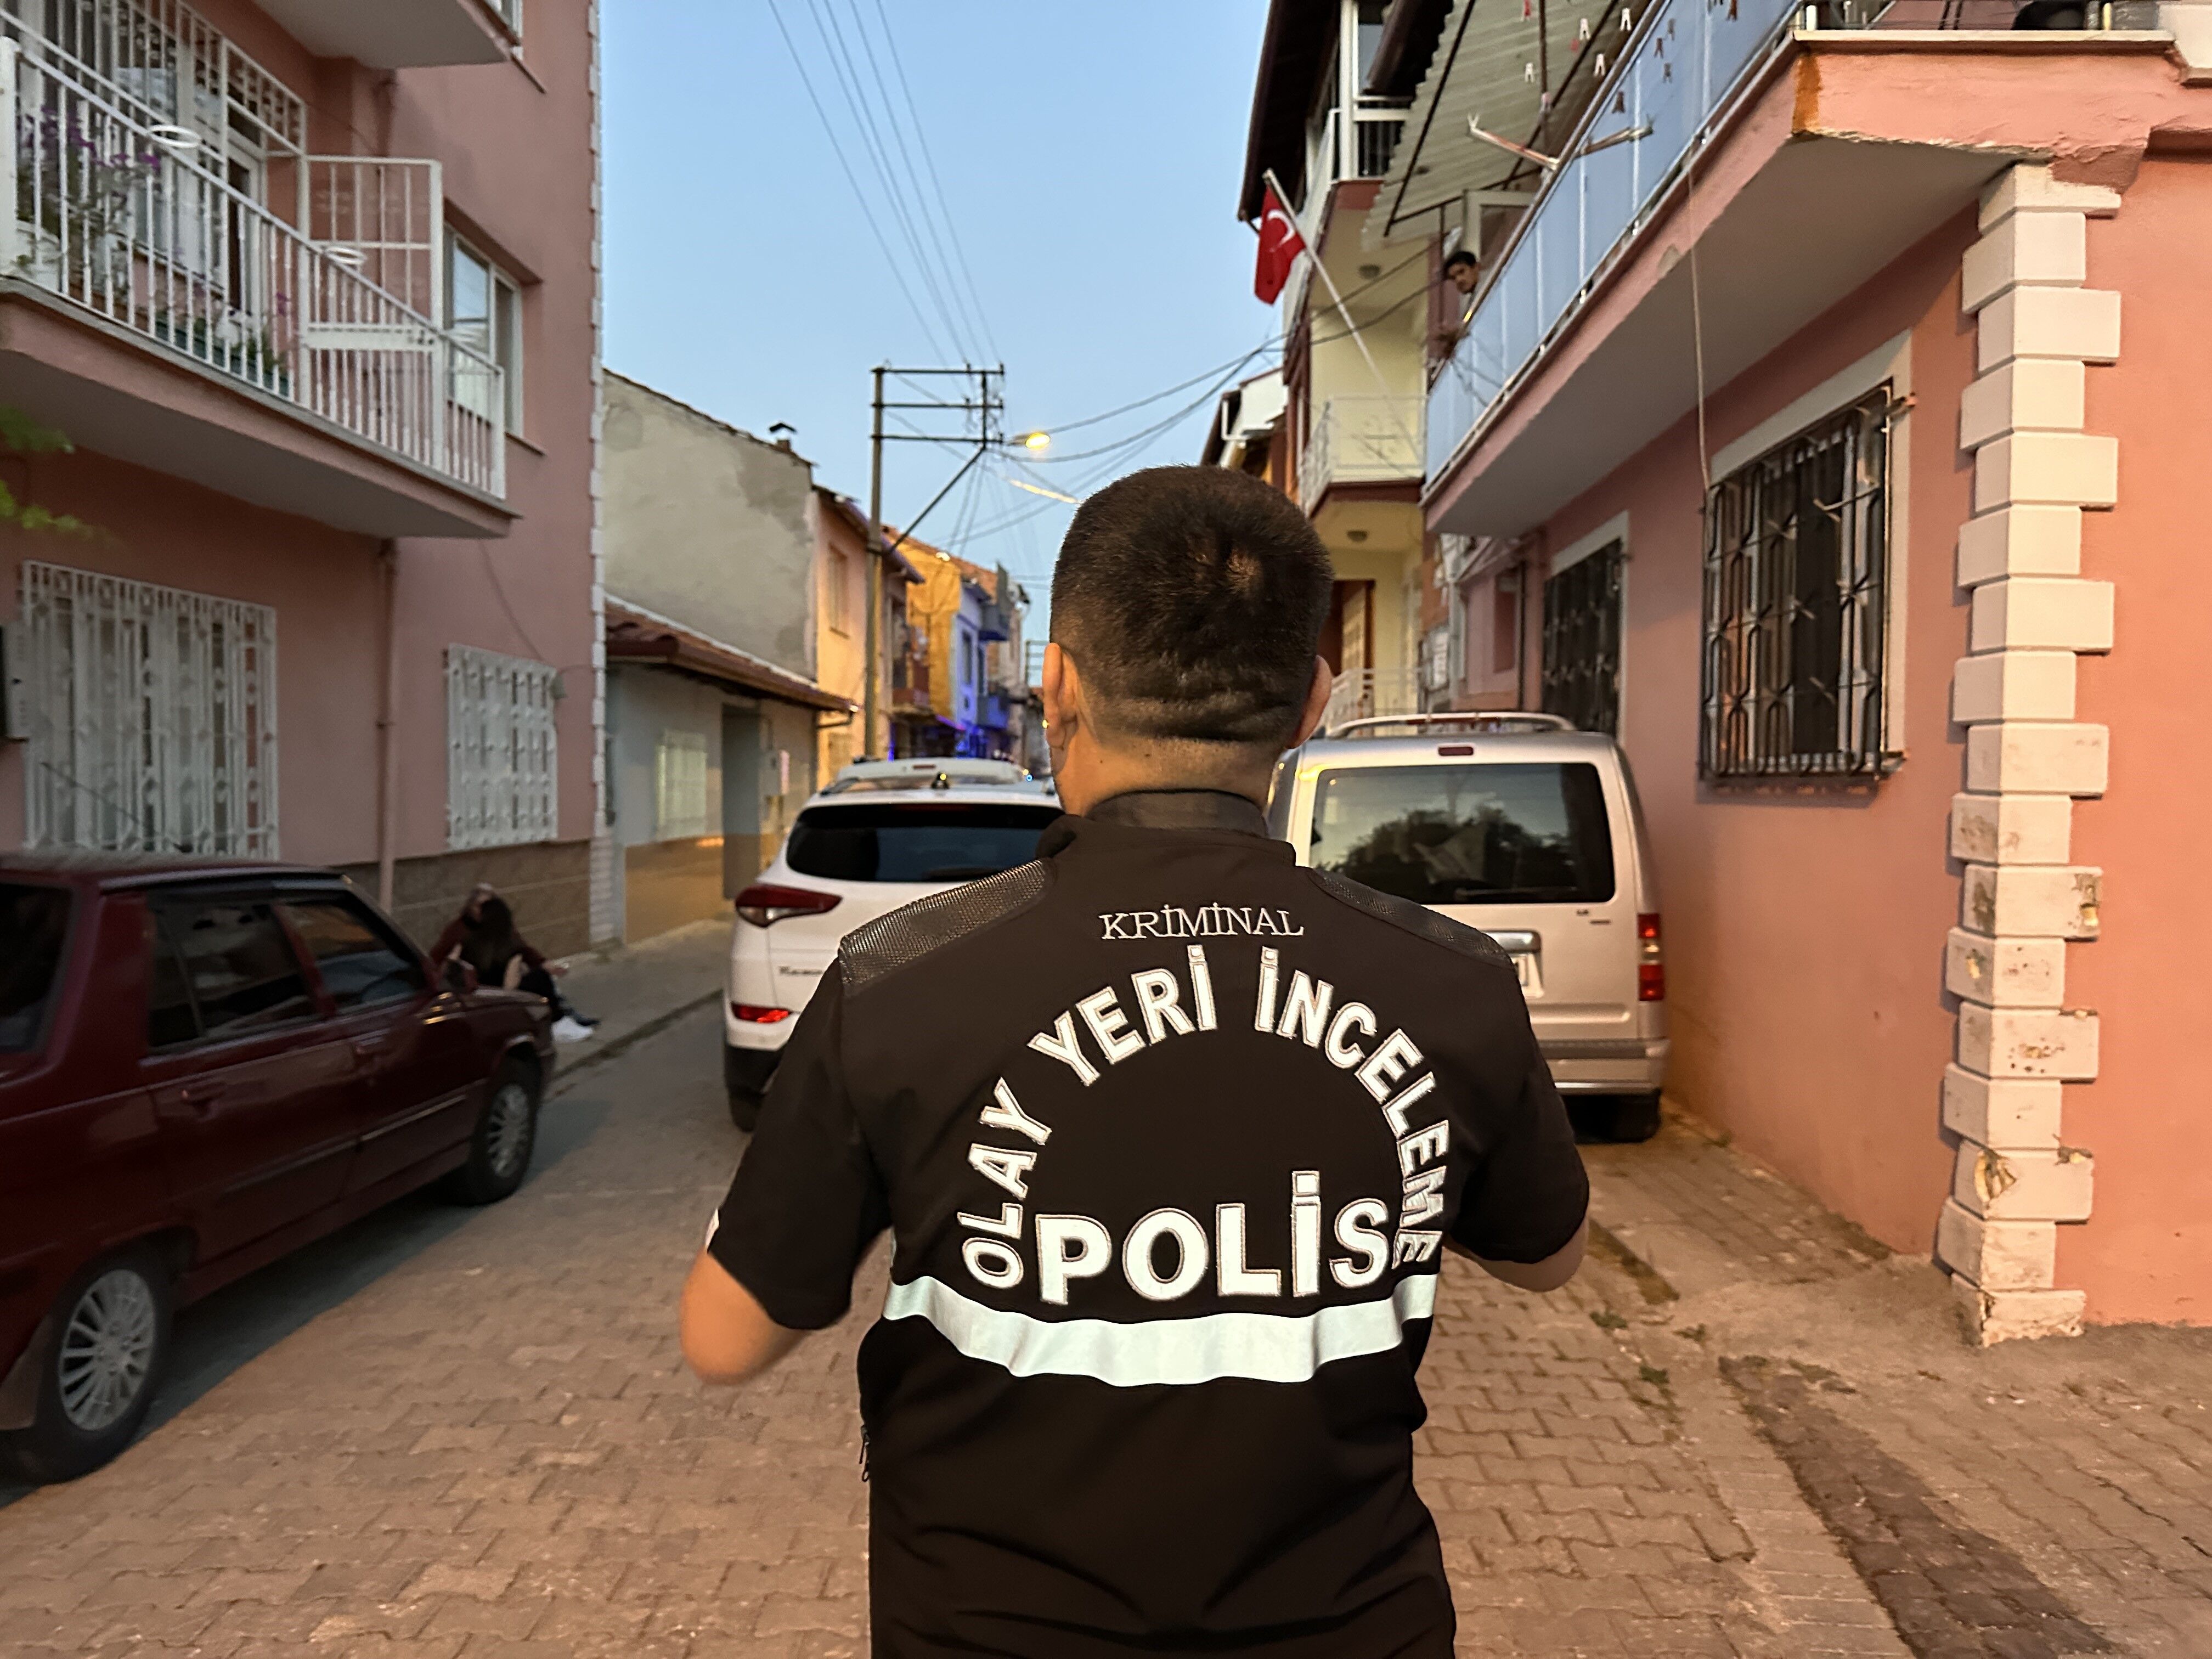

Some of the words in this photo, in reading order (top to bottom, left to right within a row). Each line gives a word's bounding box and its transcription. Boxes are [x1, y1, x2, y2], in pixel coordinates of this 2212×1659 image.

[1098, 902, 1305, 940] KRİMİNAL
[957, 1077, 1053, 1289] OLAY
[1026, 944, 1218, 1087] YERİ
[1255, 945, 1450, 1269] İNCELEME
[1035, 1170, 1390, 1305] POLİS
